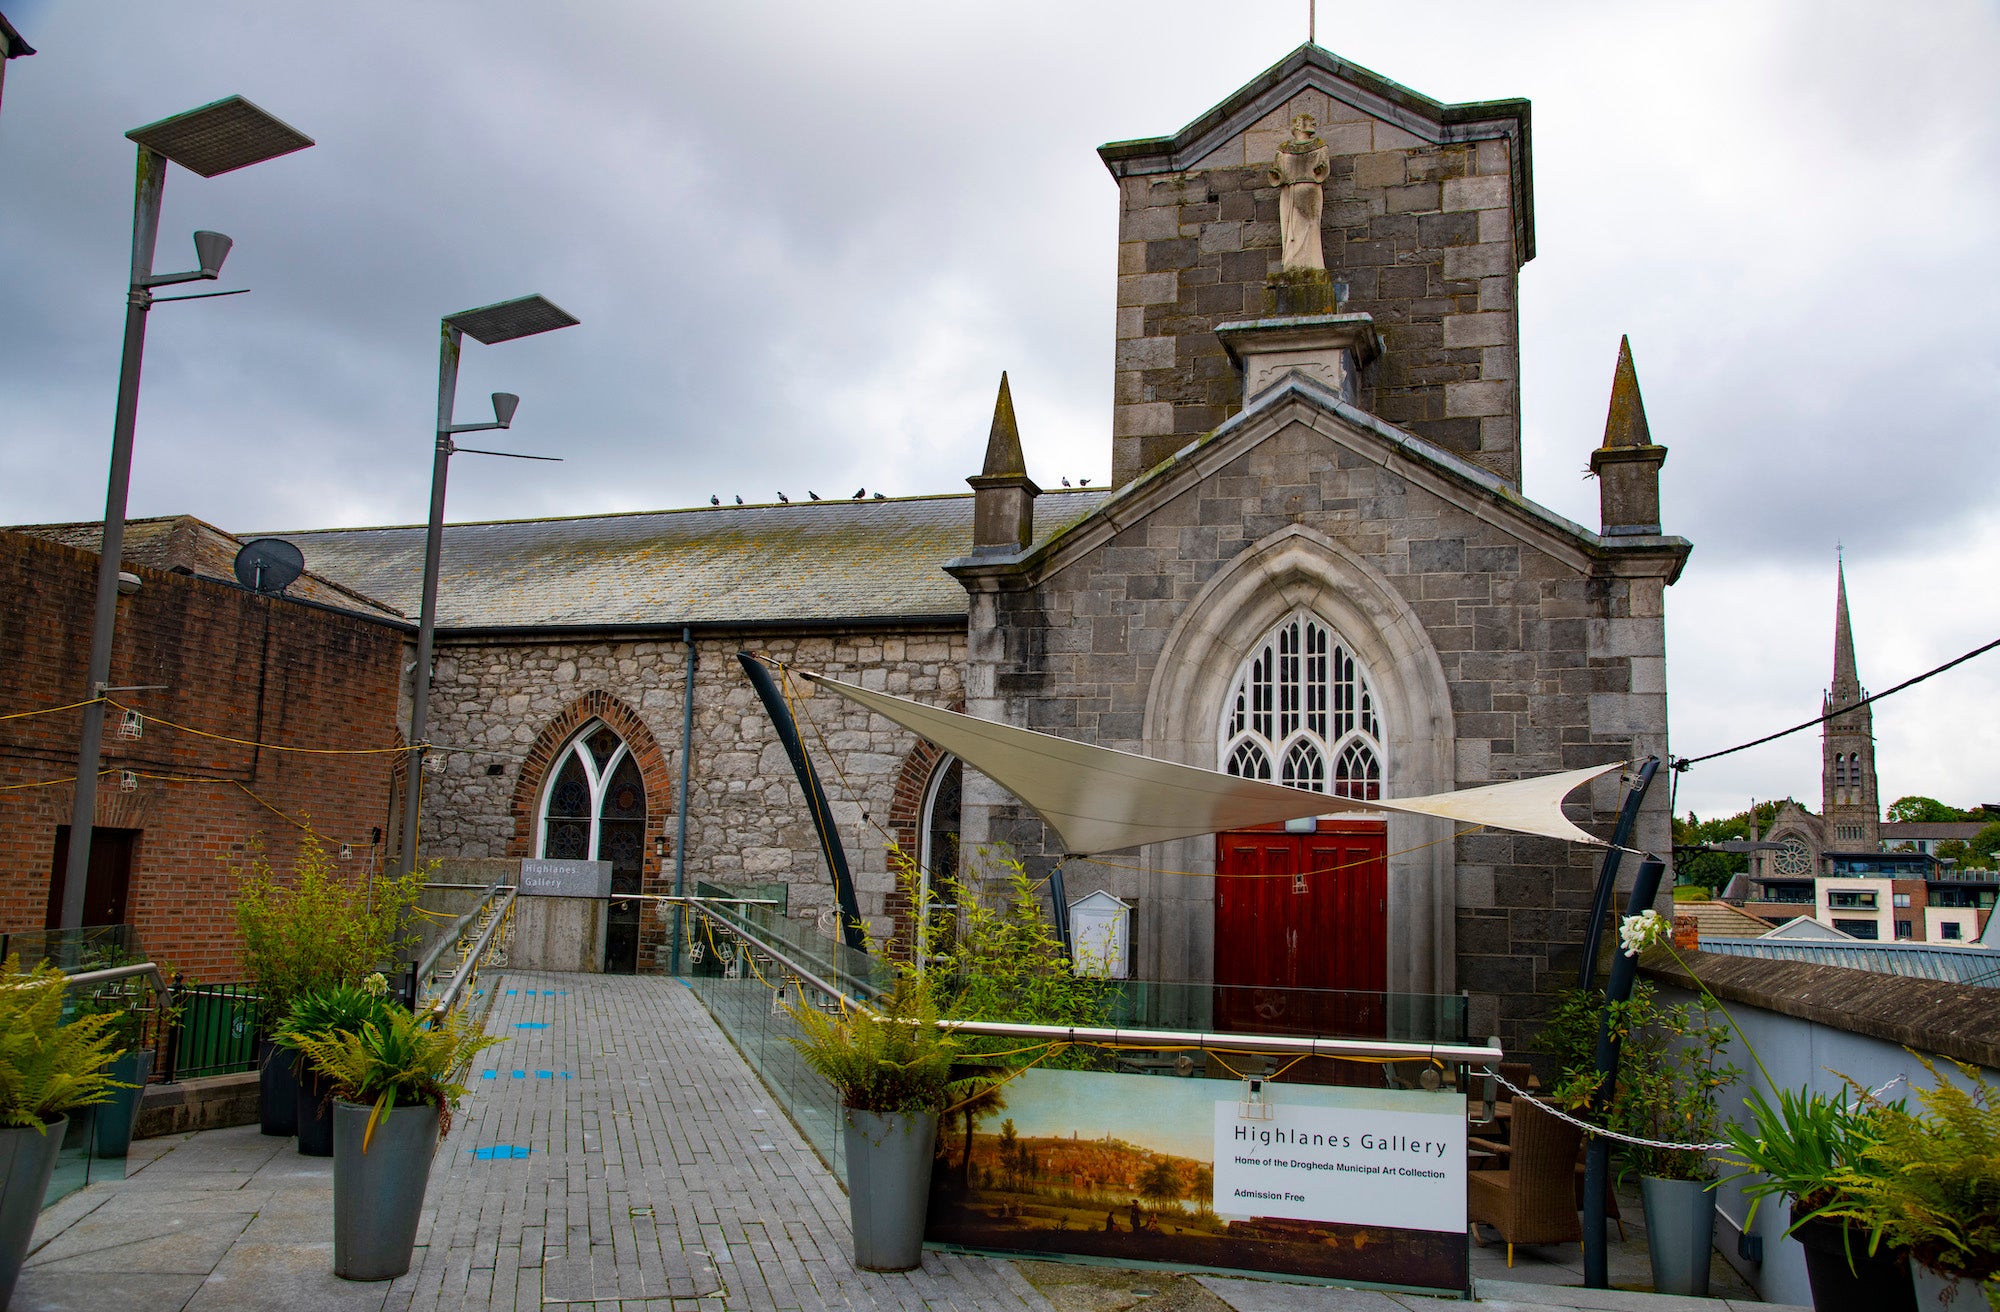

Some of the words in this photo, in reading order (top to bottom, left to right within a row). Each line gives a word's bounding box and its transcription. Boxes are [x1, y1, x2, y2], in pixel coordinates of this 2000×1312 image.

[525, 864, 576, 874] Highlanes
[525, 878, 562, 888] Gallery
[1234, 1125, 1350, 1148] Highlanes
[1361, 1133, 1447, 1158] Gallery
[1234, 1156, 1261, 1166] Home
[1262, 1158, 1272, 1167] of
[1274, 1159, 1288, 1168] the
[1290, 1159, 1334, 1171] Drogheda
[1336, 1163, 1380, 1175] Municipal
[1382, 1165, 1396, 1176] Art
[1398, 1167, 1445, 1179] Collection
[1234, 1188, 1282, 1200] Admission
[1284, 1192, 1305, 1202] Free
